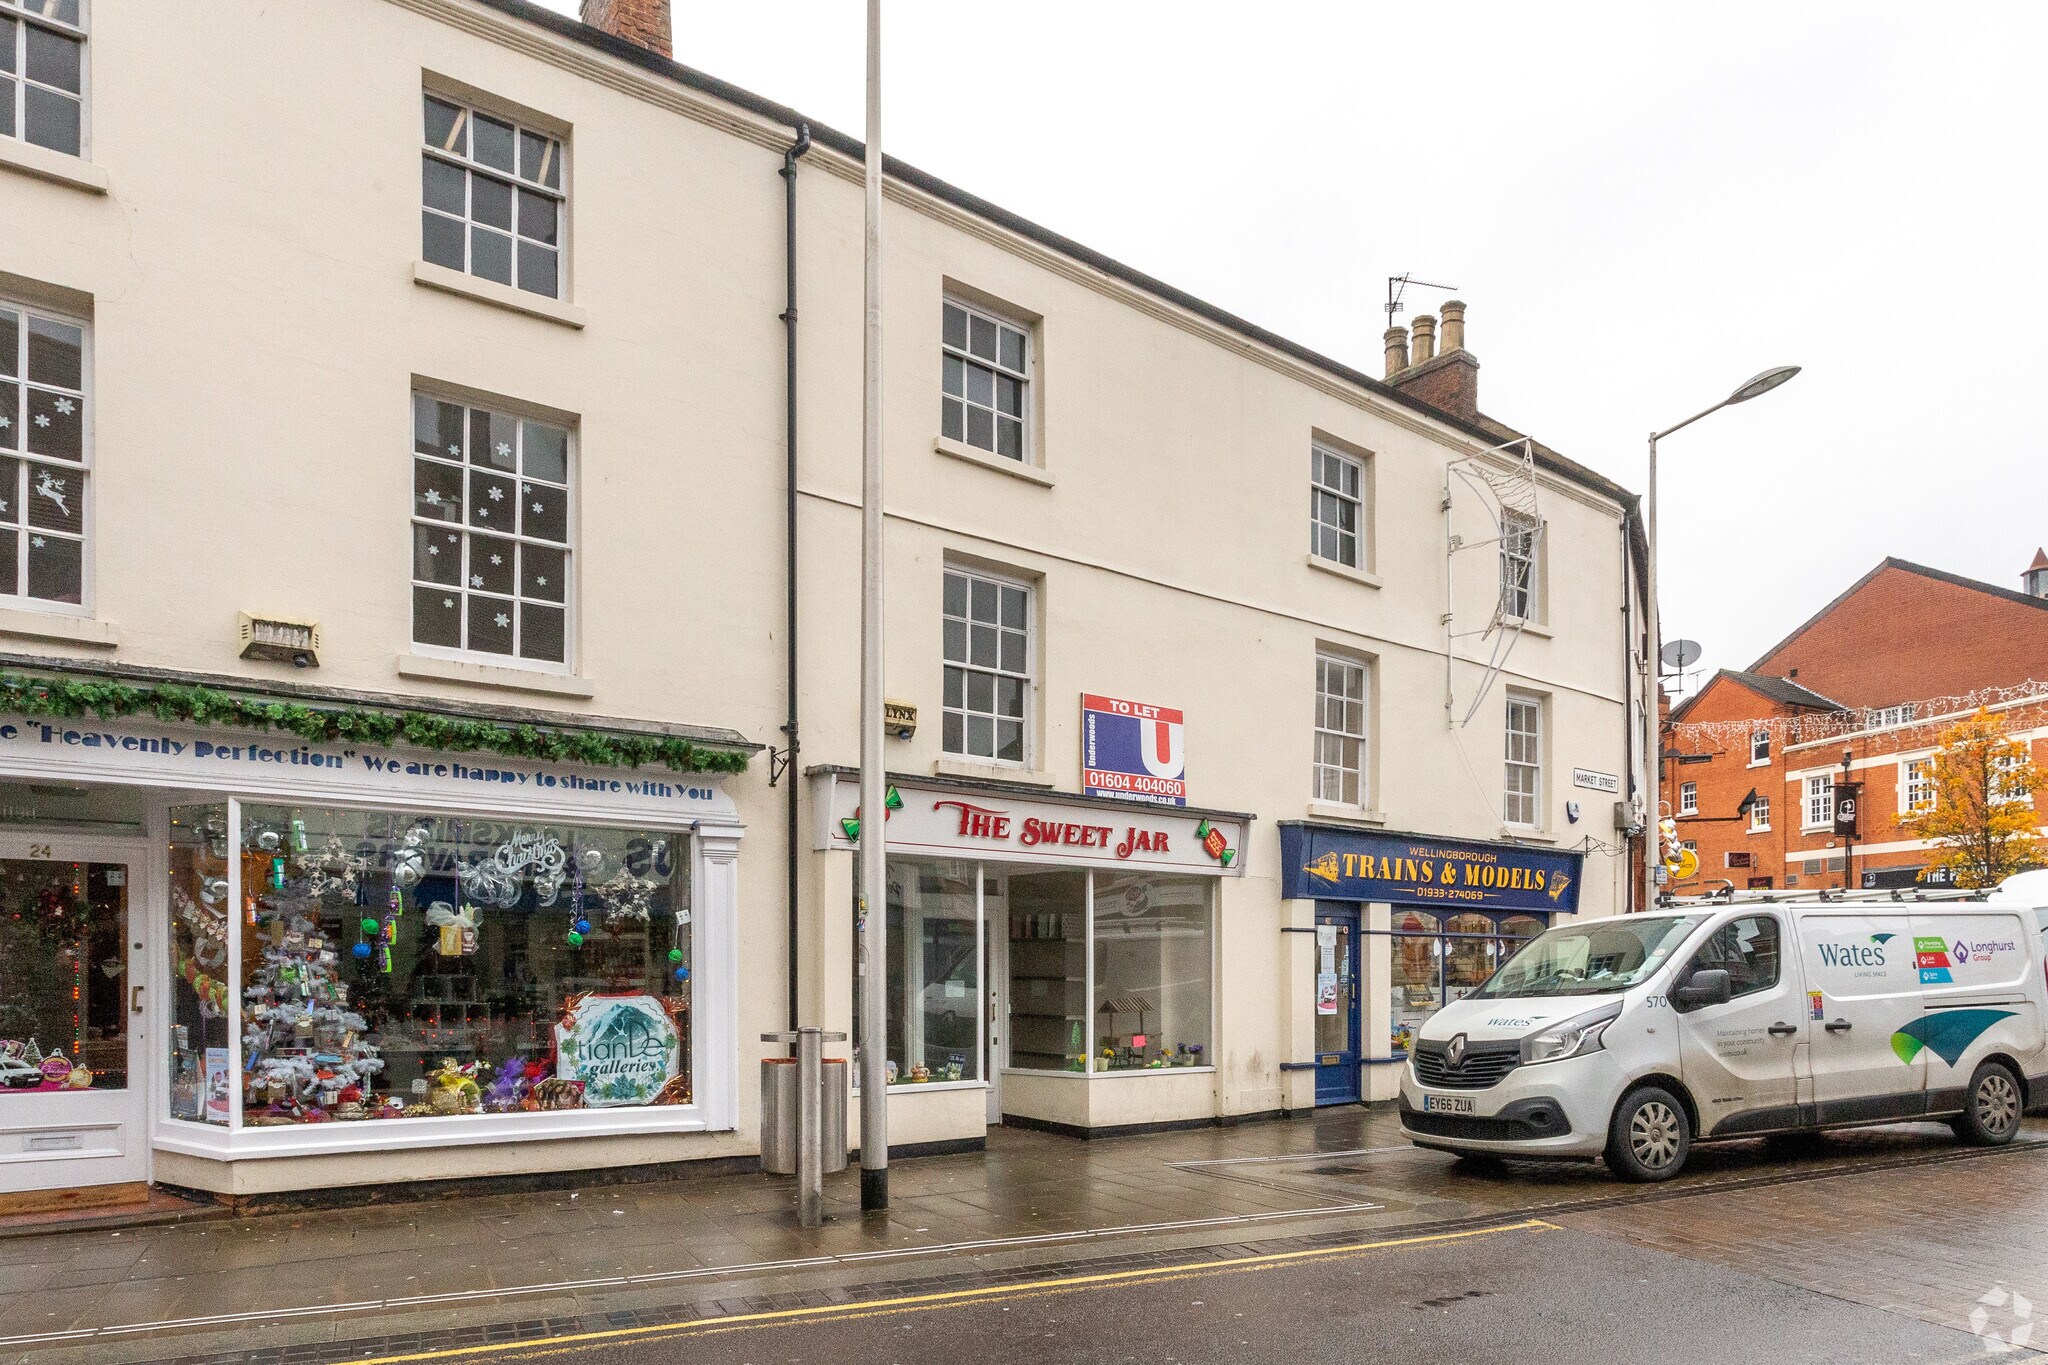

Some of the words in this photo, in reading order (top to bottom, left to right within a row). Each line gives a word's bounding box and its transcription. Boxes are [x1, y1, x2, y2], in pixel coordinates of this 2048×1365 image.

[885, 708, 914, 721] LYNX
[1110, 700, 1130, 713] TO
[1134, 704, 1160, 718] LET
[1088, 713, 1096, 767] Underwoods
[362, 755, 401, 774] We
[405, 761, 448, 778] are
[452, 763, 533, 785] happy
[535, 771, 557, 788] to
[560, 774, 621, 793] share
[625, 779, 672, 798] with
[1089, 772, 1131, 789] 01604
[1134, 777, 1182, 795] 404060
[1576, 772, 1598, 785] MARKET
[1598, 777, 1617, 789] STREET
[1096, 789, 1177, 806] www.underwoods.co.uk
[934, 800, 1010, 840] THE
[1020, 817, 1113, 847] SWEET
[1116, 827, 1170, 859] JAR
[510, 830, 546, 849] Merry
[30, 844, 51, 858] 24
[495, 838, 566, 875] Christmas
[1409, 846, 1497, 863] WELLINGBOROUGH
[1342, 853, 1433, 883] TRAINS
[1440, 862, 1457, 885] &
[1463, 864, 1546, 891] MODELS
[1818, 943, 1885, 967] Wates
[1970, 939, 2015, 954] Longhurst
[1973, 953, 1992, 963] Group
[1646, 996, 1667, 1008] 570
[1429, 1098, 1453, 1112] EY66
[1454, 1099, 1473, 1113] ZUA
